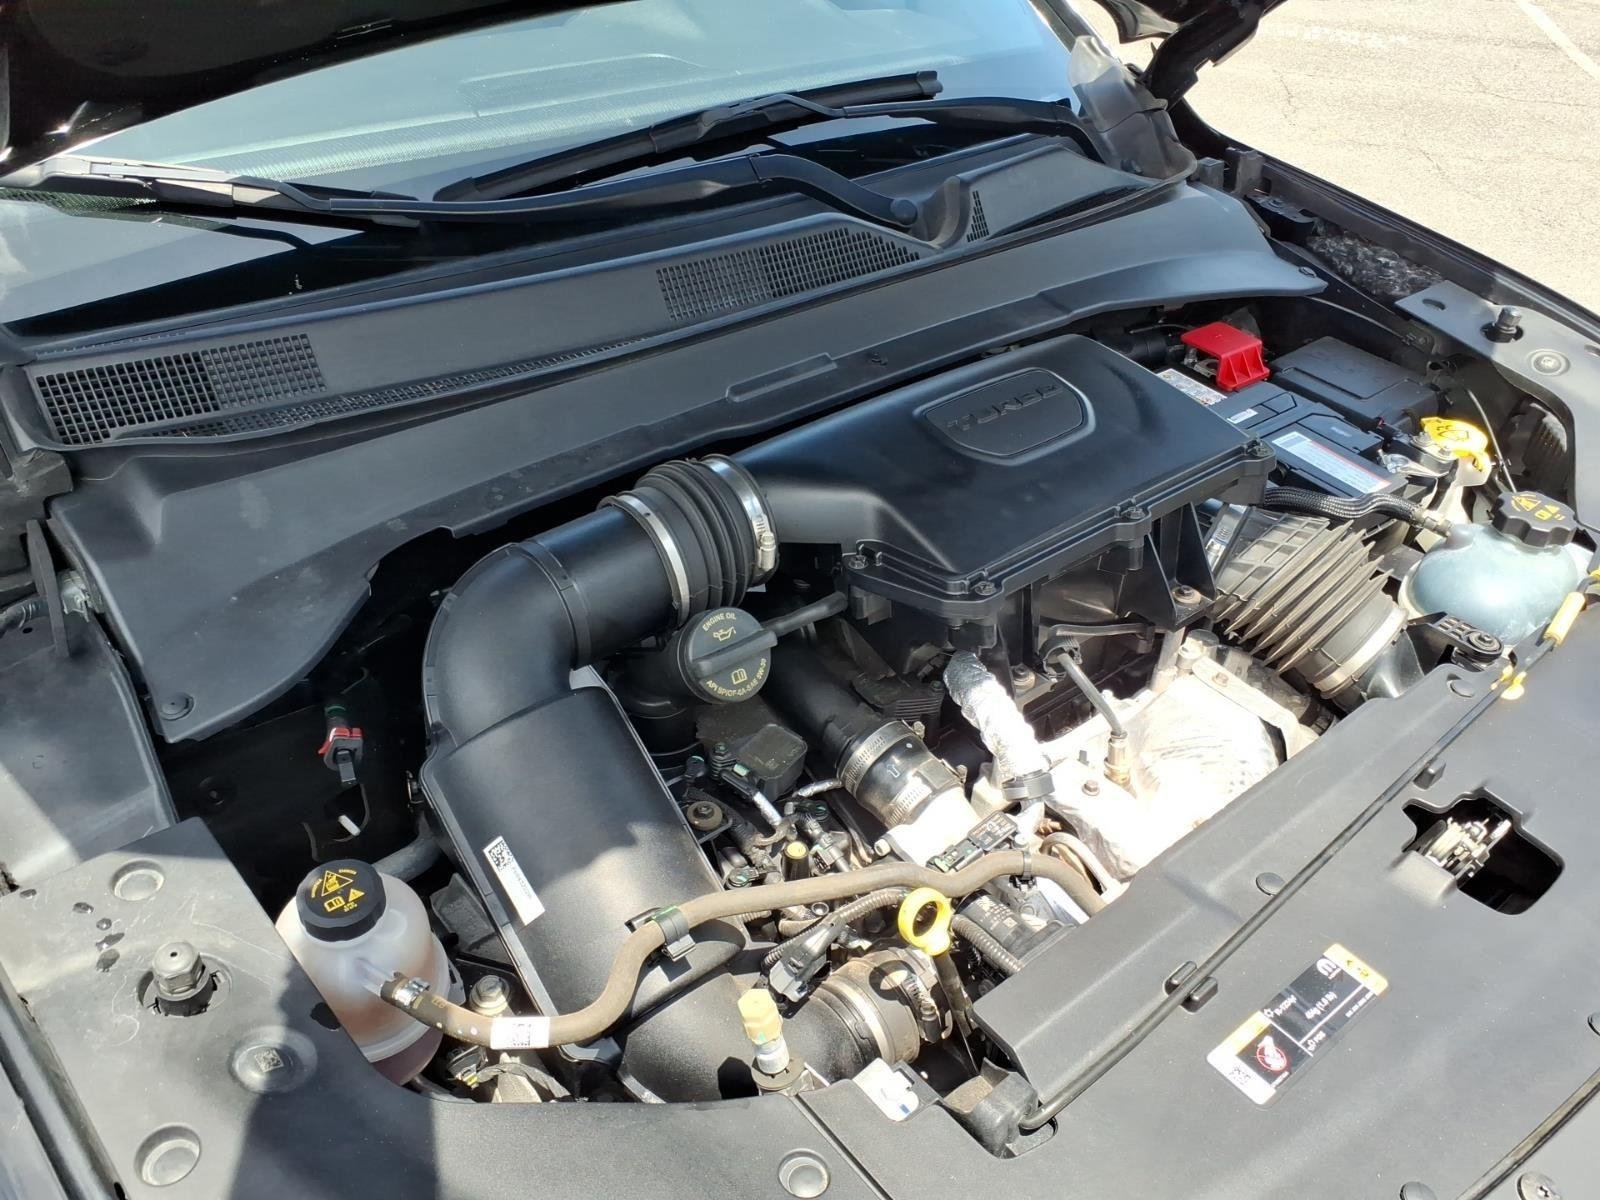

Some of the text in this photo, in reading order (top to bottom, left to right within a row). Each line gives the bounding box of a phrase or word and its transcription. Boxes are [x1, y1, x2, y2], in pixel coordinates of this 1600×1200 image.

[703, 612, 737, 631] ENGINE OIL
[706, 681, 719, 692] API
